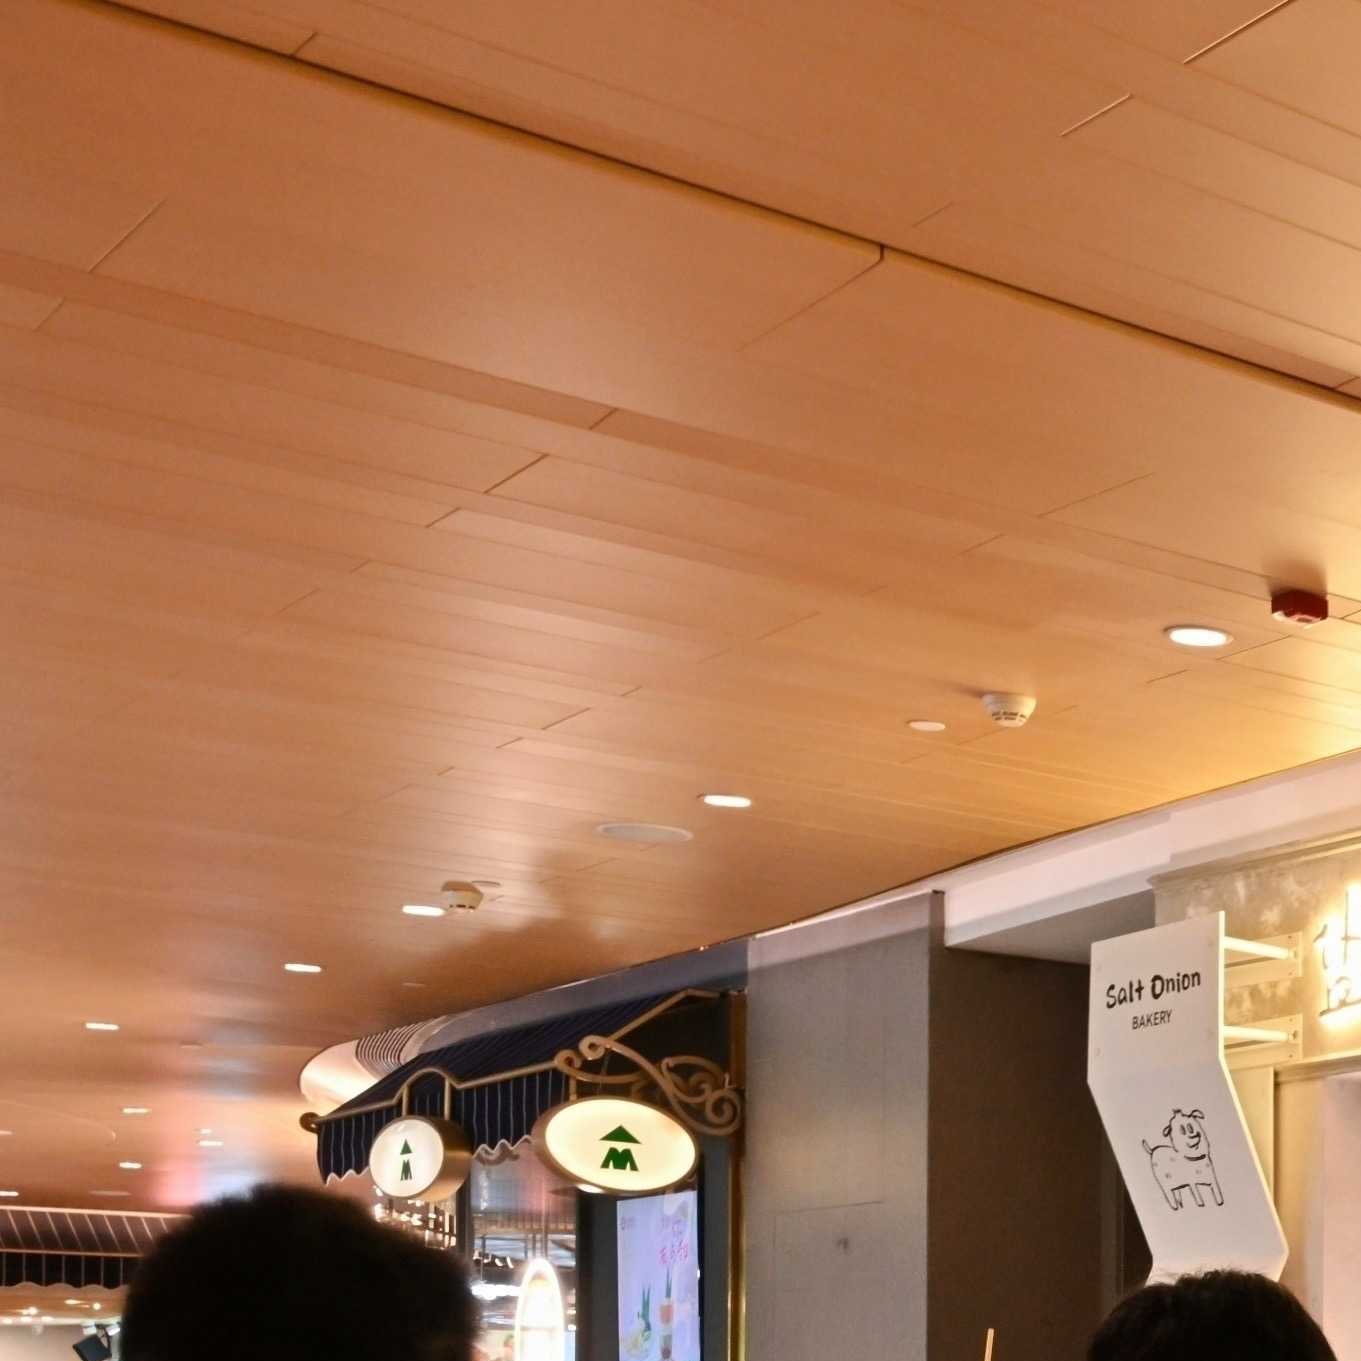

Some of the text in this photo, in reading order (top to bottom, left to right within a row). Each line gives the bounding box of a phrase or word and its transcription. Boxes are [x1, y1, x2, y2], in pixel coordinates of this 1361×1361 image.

[1106, 971, 1201, 1009] Salt Onion
[1132, 1009, 1173, 1030] BAKERY
